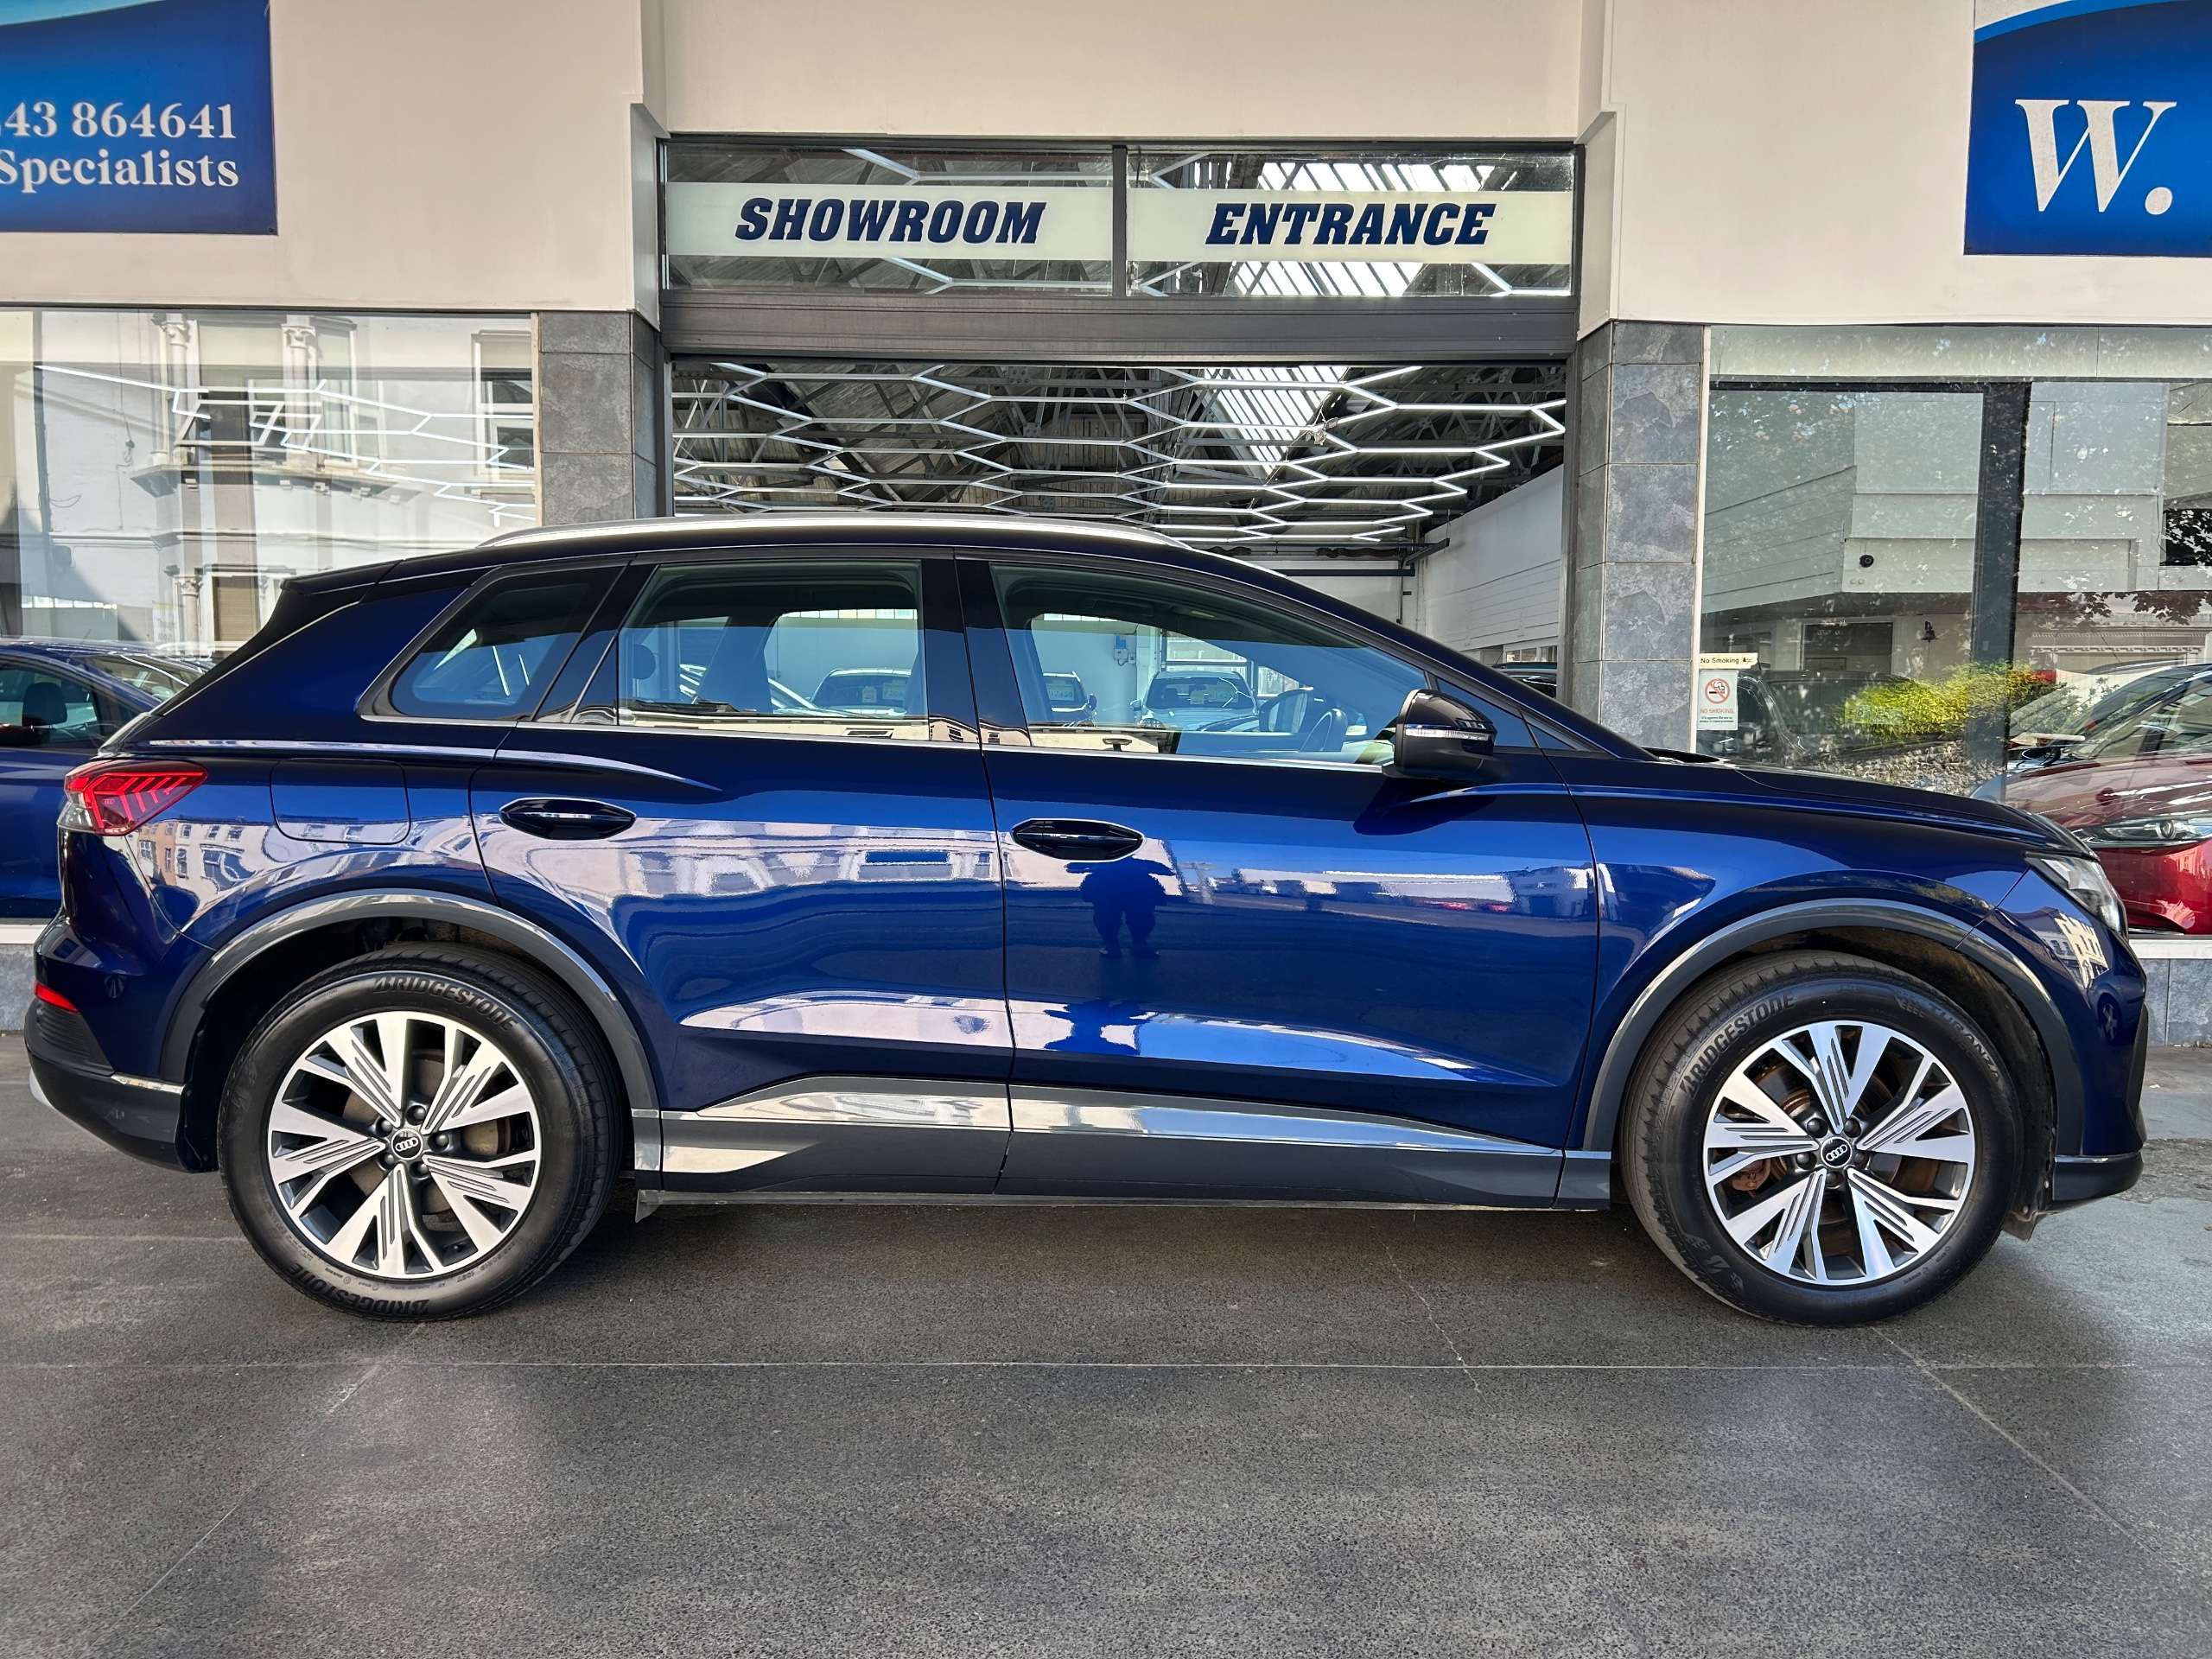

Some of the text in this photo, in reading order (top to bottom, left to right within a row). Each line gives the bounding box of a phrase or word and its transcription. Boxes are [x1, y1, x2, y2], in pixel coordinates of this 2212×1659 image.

[0, 101, 236, 138] 43 864641
[0, 148, 238, 194] Specialists
[734, 198, 1046, 244] SHOWROOM
[1205, 203, 1497, 245] ENTRANCE
[372, 976, 519, 1031] BRIDGESTONE
[1679, 995, 1796, 1100] BRIDGESTONE
